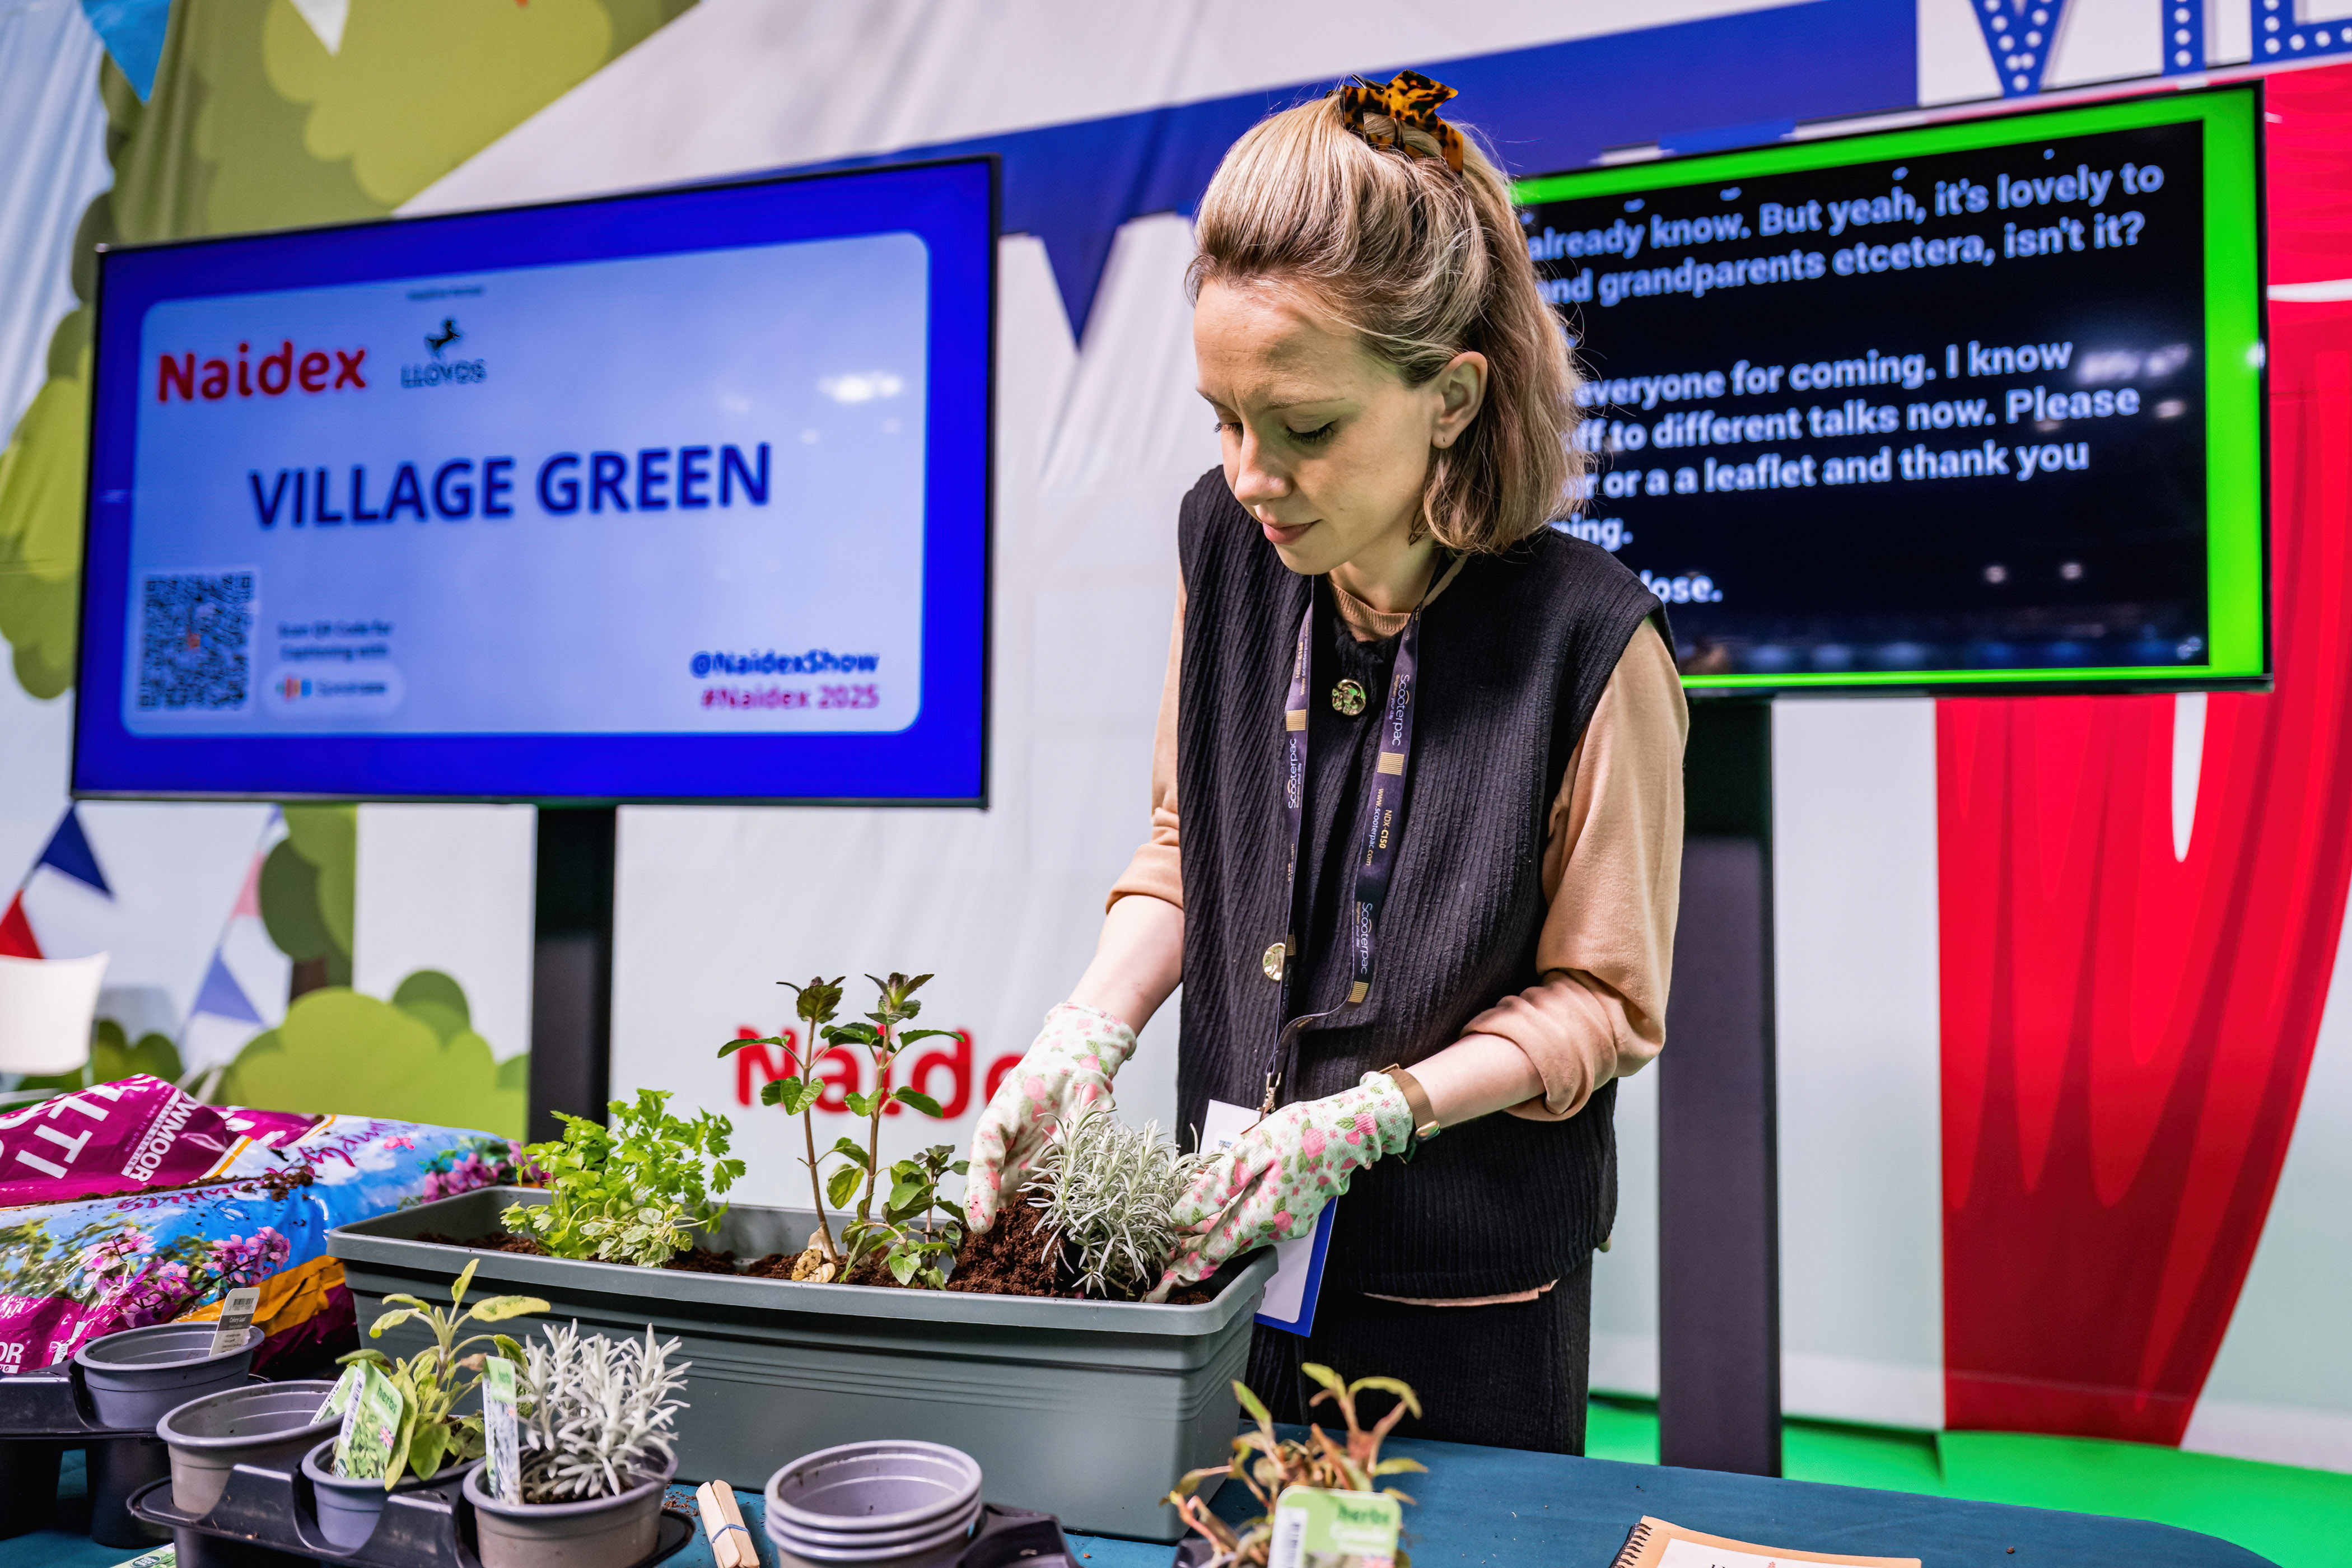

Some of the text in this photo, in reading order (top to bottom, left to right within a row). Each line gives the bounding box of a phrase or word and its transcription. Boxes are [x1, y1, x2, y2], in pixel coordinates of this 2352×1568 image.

[1528, 162, 2164, 259] already know. But yeah, it's lovely to
[1598, 249, 1826, 307] grandparents
[1832, 236, 1995, 276] etcetera,
[2004, 217, 2084, 258] isn't
[2094, 211, 2145, 248] it?
[157, 340, 367, 403] Naidex
[400, 358, 487, 388] LLOYDS
[1730, 360, 1784, 395] for
[1789, 349, 1936, 391] coming.
[1945, 344, 1959, 379] I
[1968, 340, 2073, 377] know
[1609, 419, 1648, 451] to
[1651, 407, 1803, 449] different
[1807, 399, 1900, 437] talks
[1906, 399, 1996, 431] now.
[2006, 385, 2140, 423] Please
[249, 441, 771, 529] VILLAGE GREEN
[1603, 470, 1642, 498] or
[1645, 468, 1670, 496] a
[1674, 466, 1698, 494] a
[1704, 452, 1817, 492] leaflet
[1822, 446, 1892, 486] and
[1898, 439, 2009, 480] thank
[2015, 442, 2089, 481] you
[690, 648, 880, 679] @NaidexShow
[701, 684, 880, 710] #Naidex 2025
[1391, 674, 1410, 746] Scooterpac
[1288, 738, 1298, 809] Scooterpac
[1365, 788, 1384, 866] www.scooterpac.com
[1379, 809, 1393, 849] NDX-C150
[1360, 902, 1373, 974] Scooterpac
[129, 1094, 198, 1182] WMOOR
[377, 1382, 397, 1415] herbs
